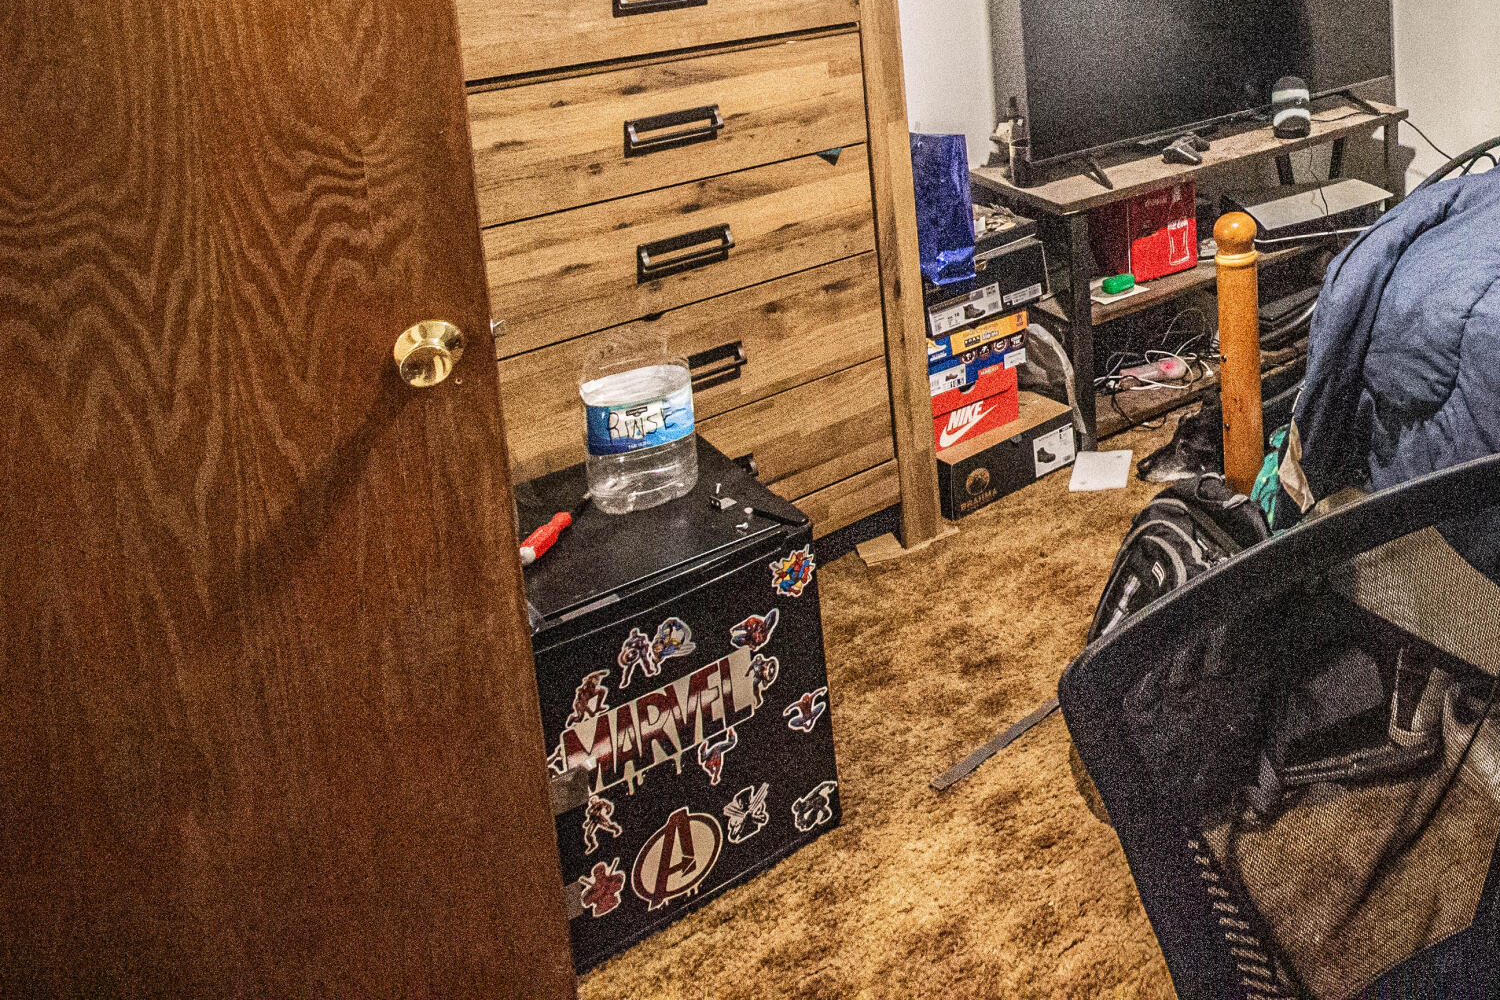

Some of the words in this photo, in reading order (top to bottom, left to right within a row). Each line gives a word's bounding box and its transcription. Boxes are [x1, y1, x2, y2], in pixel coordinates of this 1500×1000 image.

[608, 405, 686, 445] RINSE
[947, 400, 984, 432] NIKE
[562, 656, 755, 795] MARVEL
